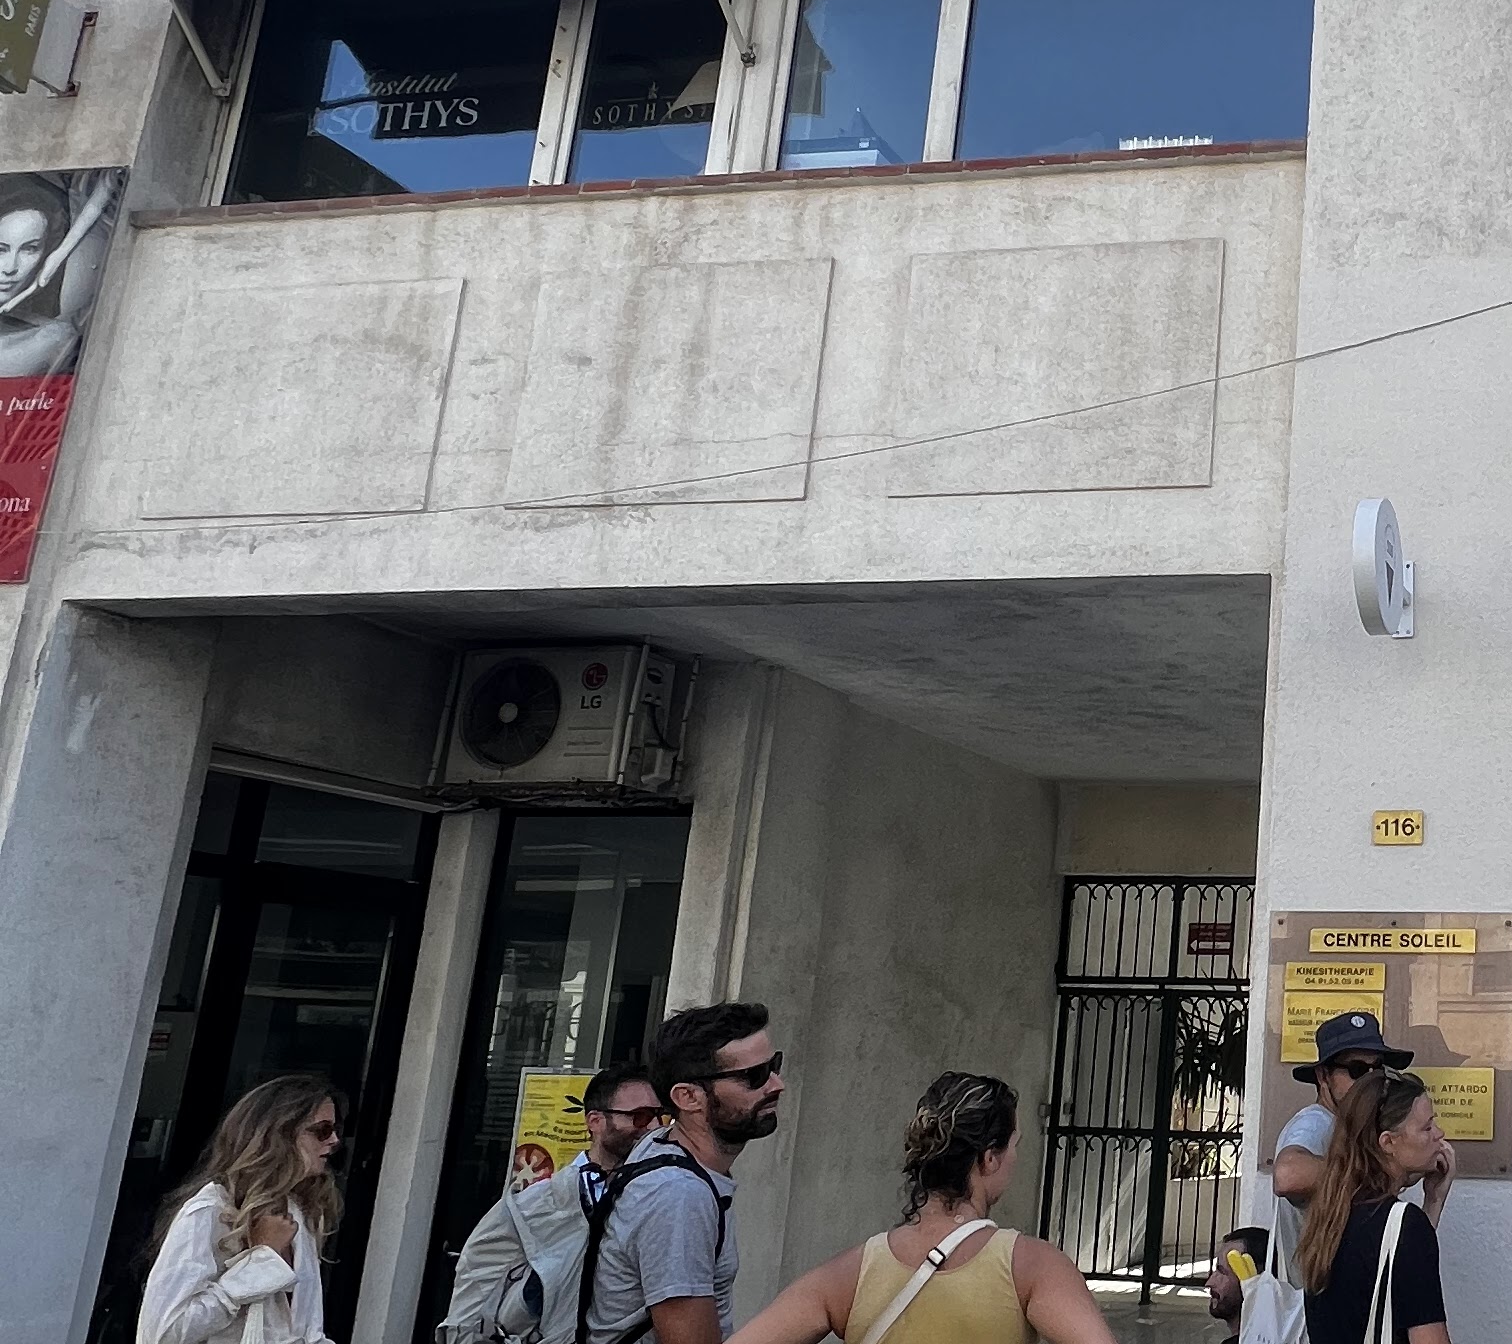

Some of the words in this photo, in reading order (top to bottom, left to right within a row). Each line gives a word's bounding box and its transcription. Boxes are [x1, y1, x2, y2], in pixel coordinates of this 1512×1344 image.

[24, 3, 41, 38] PARIS
[326, 97, 480, 135] SOTHYS
[592, 101, 695, 125] SOTHYS
[6, 391, 55, 416] parle
[580, 695, 602, 710] LG
[1380, 817, 1415, 837] 116
[1323, 932, 1393, 948] CENTRE
[1399, 933, 1462, 948] SOLEIL
[1295, 967, 1375, 976] KINESITHERAPIE
[1441, 1084, 1488, 1094] ATTARDO
